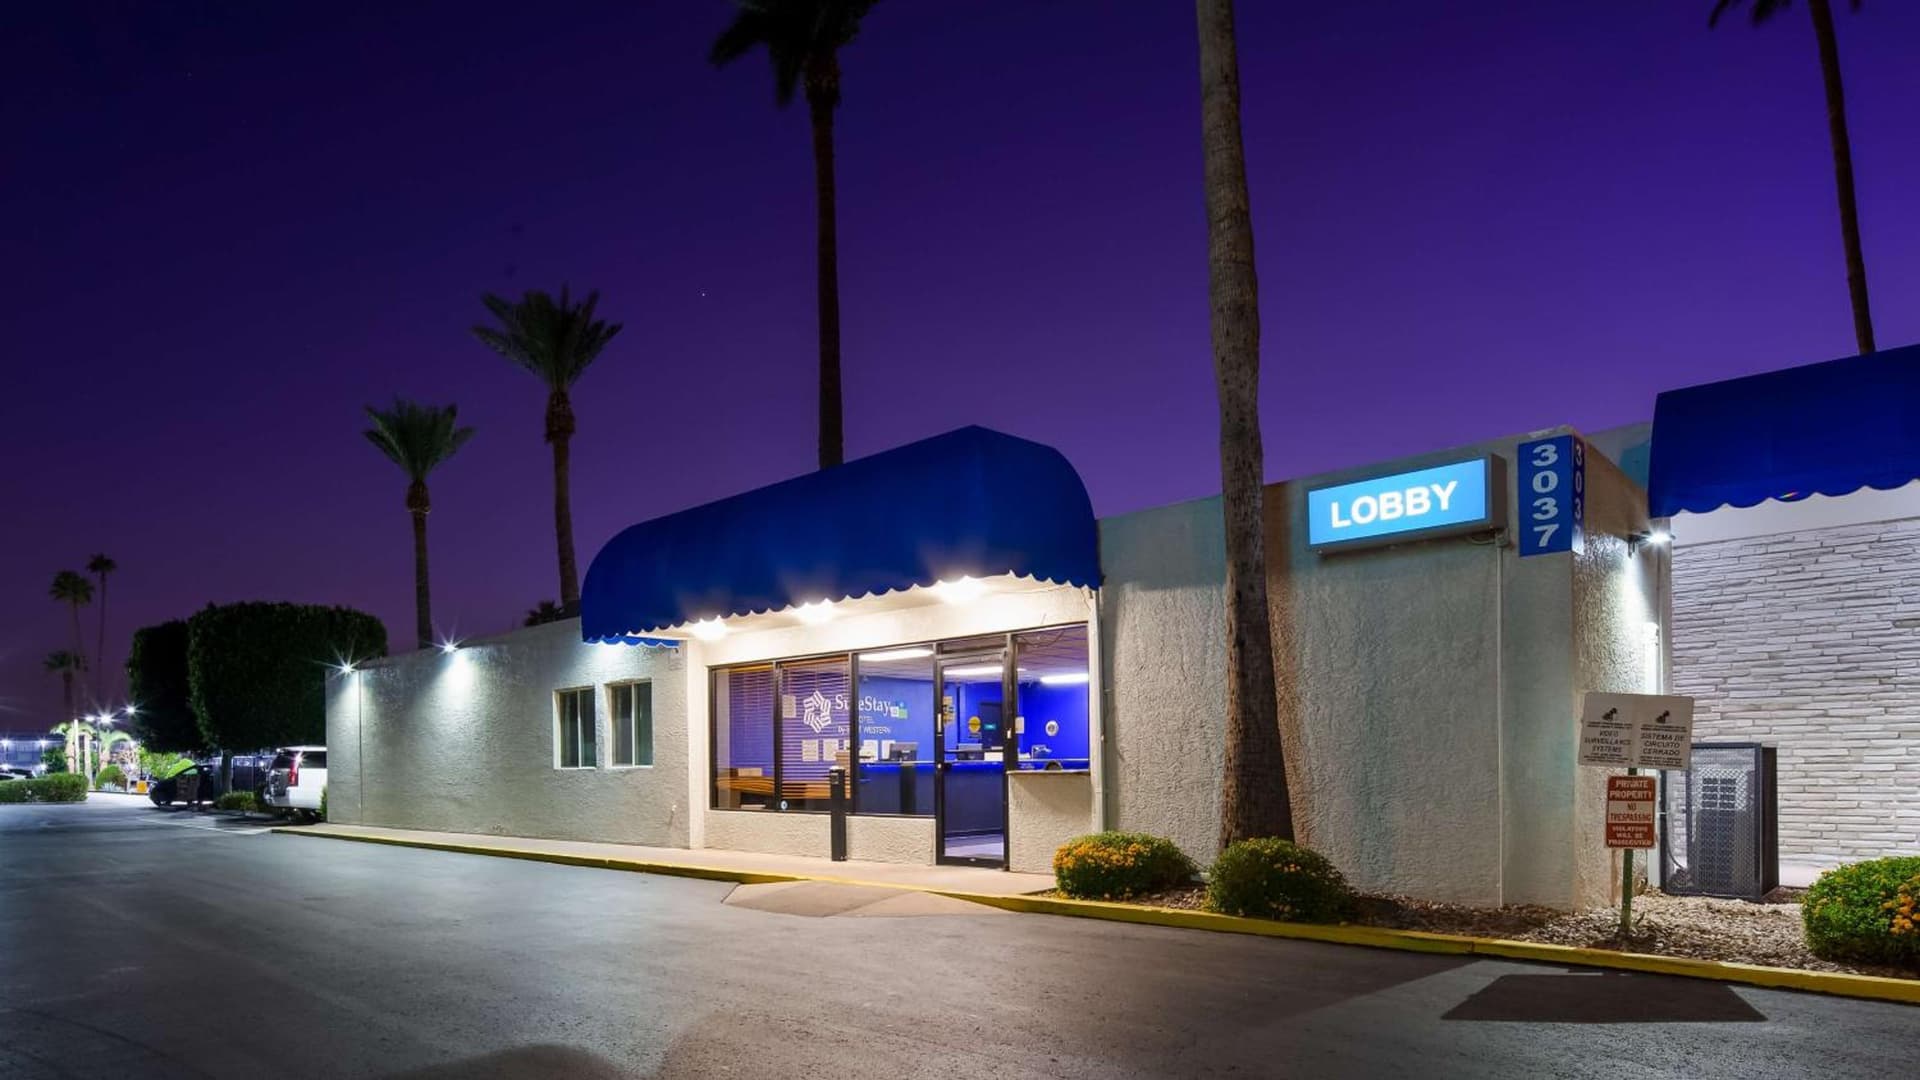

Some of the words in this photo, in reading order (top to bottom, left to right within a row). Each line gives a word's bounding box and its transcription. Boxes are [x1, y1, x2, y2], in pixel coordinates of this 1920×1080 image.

[1532, 443, 1559, 548] 3037
[1331, 480, 1458, 528] LOBBY
[836, 694, 890, 717] SueStay
[1599, 729, 1618, 737] VIDEO
[1640, 732, 1673, 741] SISTEMA
[1674, 734, 1685, 742] DE
[1644, 740, 1681, 748] CIRCUITO
[1643, 748, 1681, 756] CERRADO
[1615, 780, 1649, 788] PRIVATE
[1609, 790, 1652, 799] PROPERTY
[1627, 802, 1637, 810] NO
[1610, 812, 1651, 821] TRESPASSING
